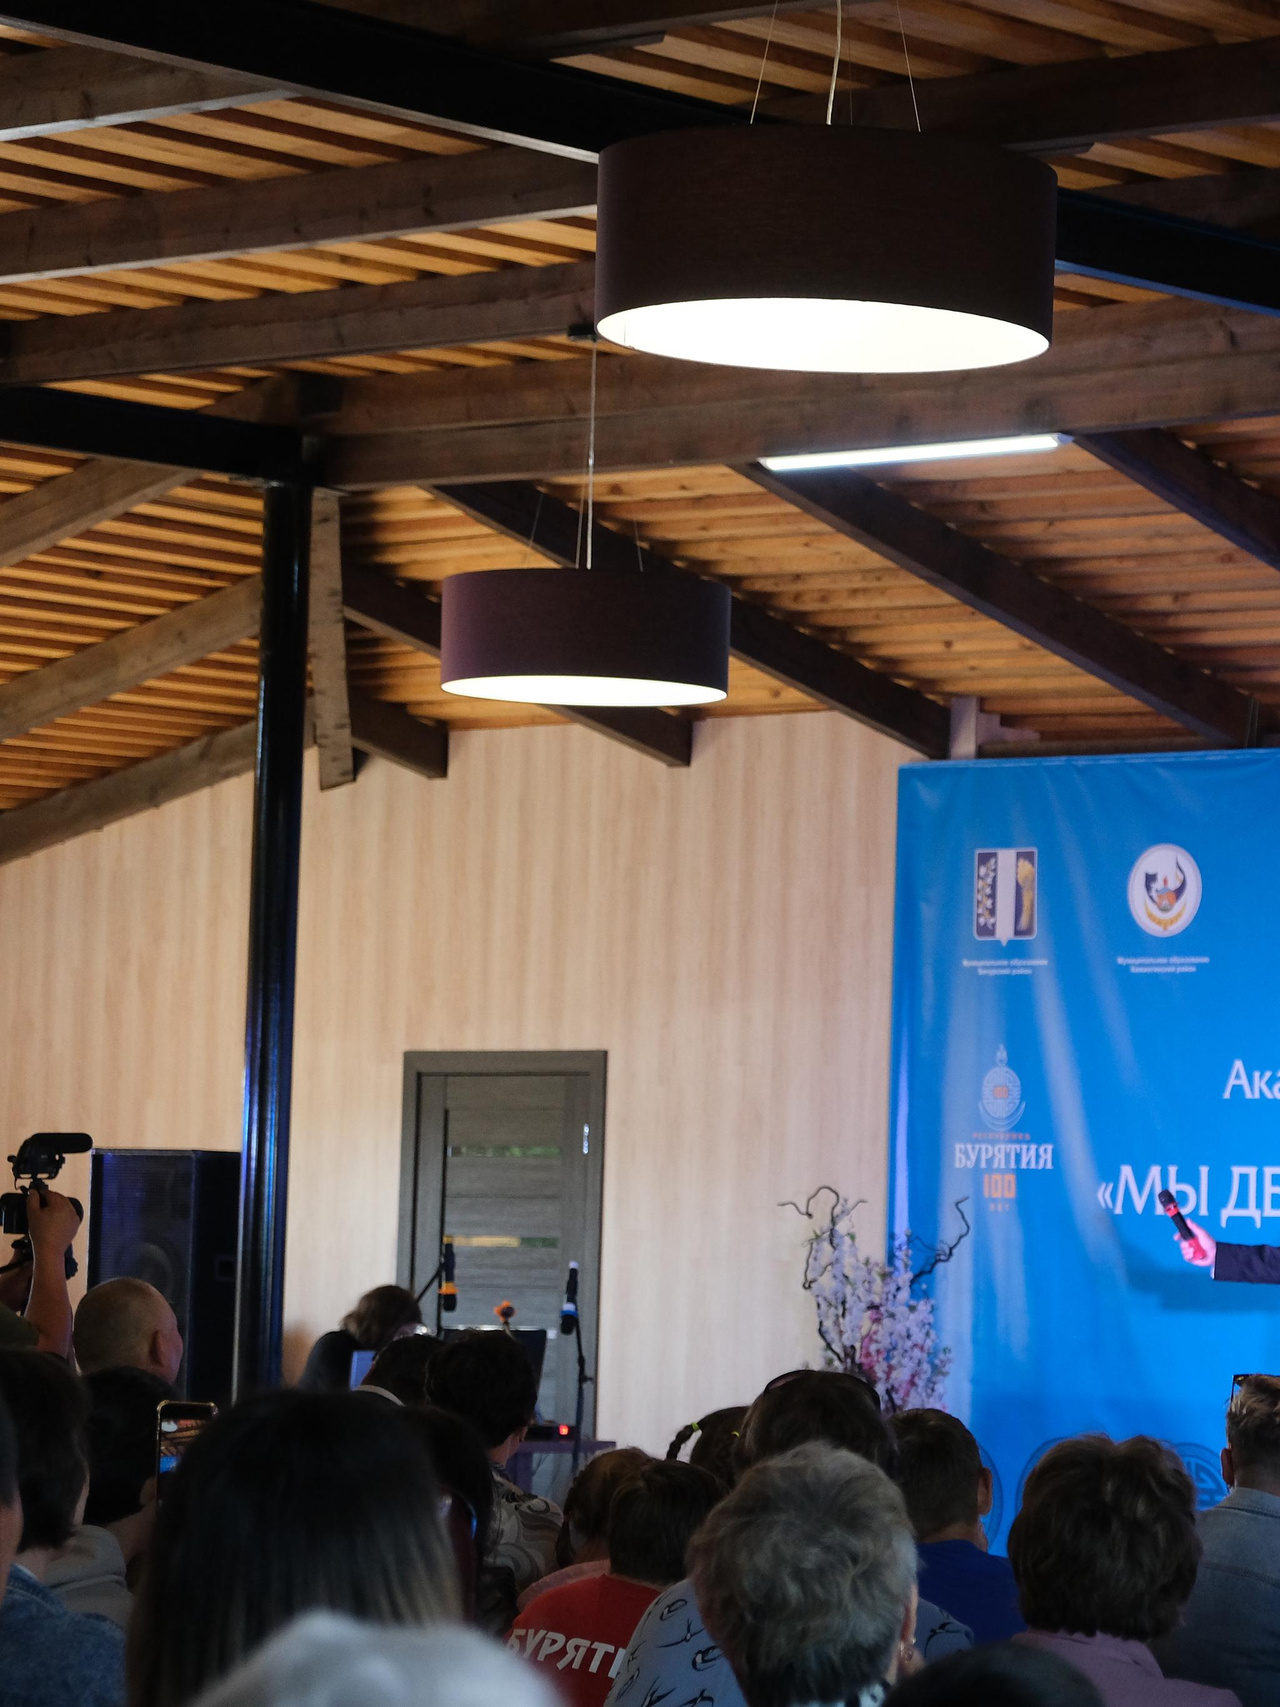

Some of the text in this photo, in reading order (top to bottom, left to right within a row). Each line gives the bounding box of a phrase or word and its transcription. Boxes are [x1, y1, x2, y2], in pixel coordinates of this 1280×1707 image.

[954, 1143, 1054, 1170] БУРЯТИЯ
[984, 1174, 1017, 1198] 100
[1097, 1164, 1210, 1217] «МЫ
